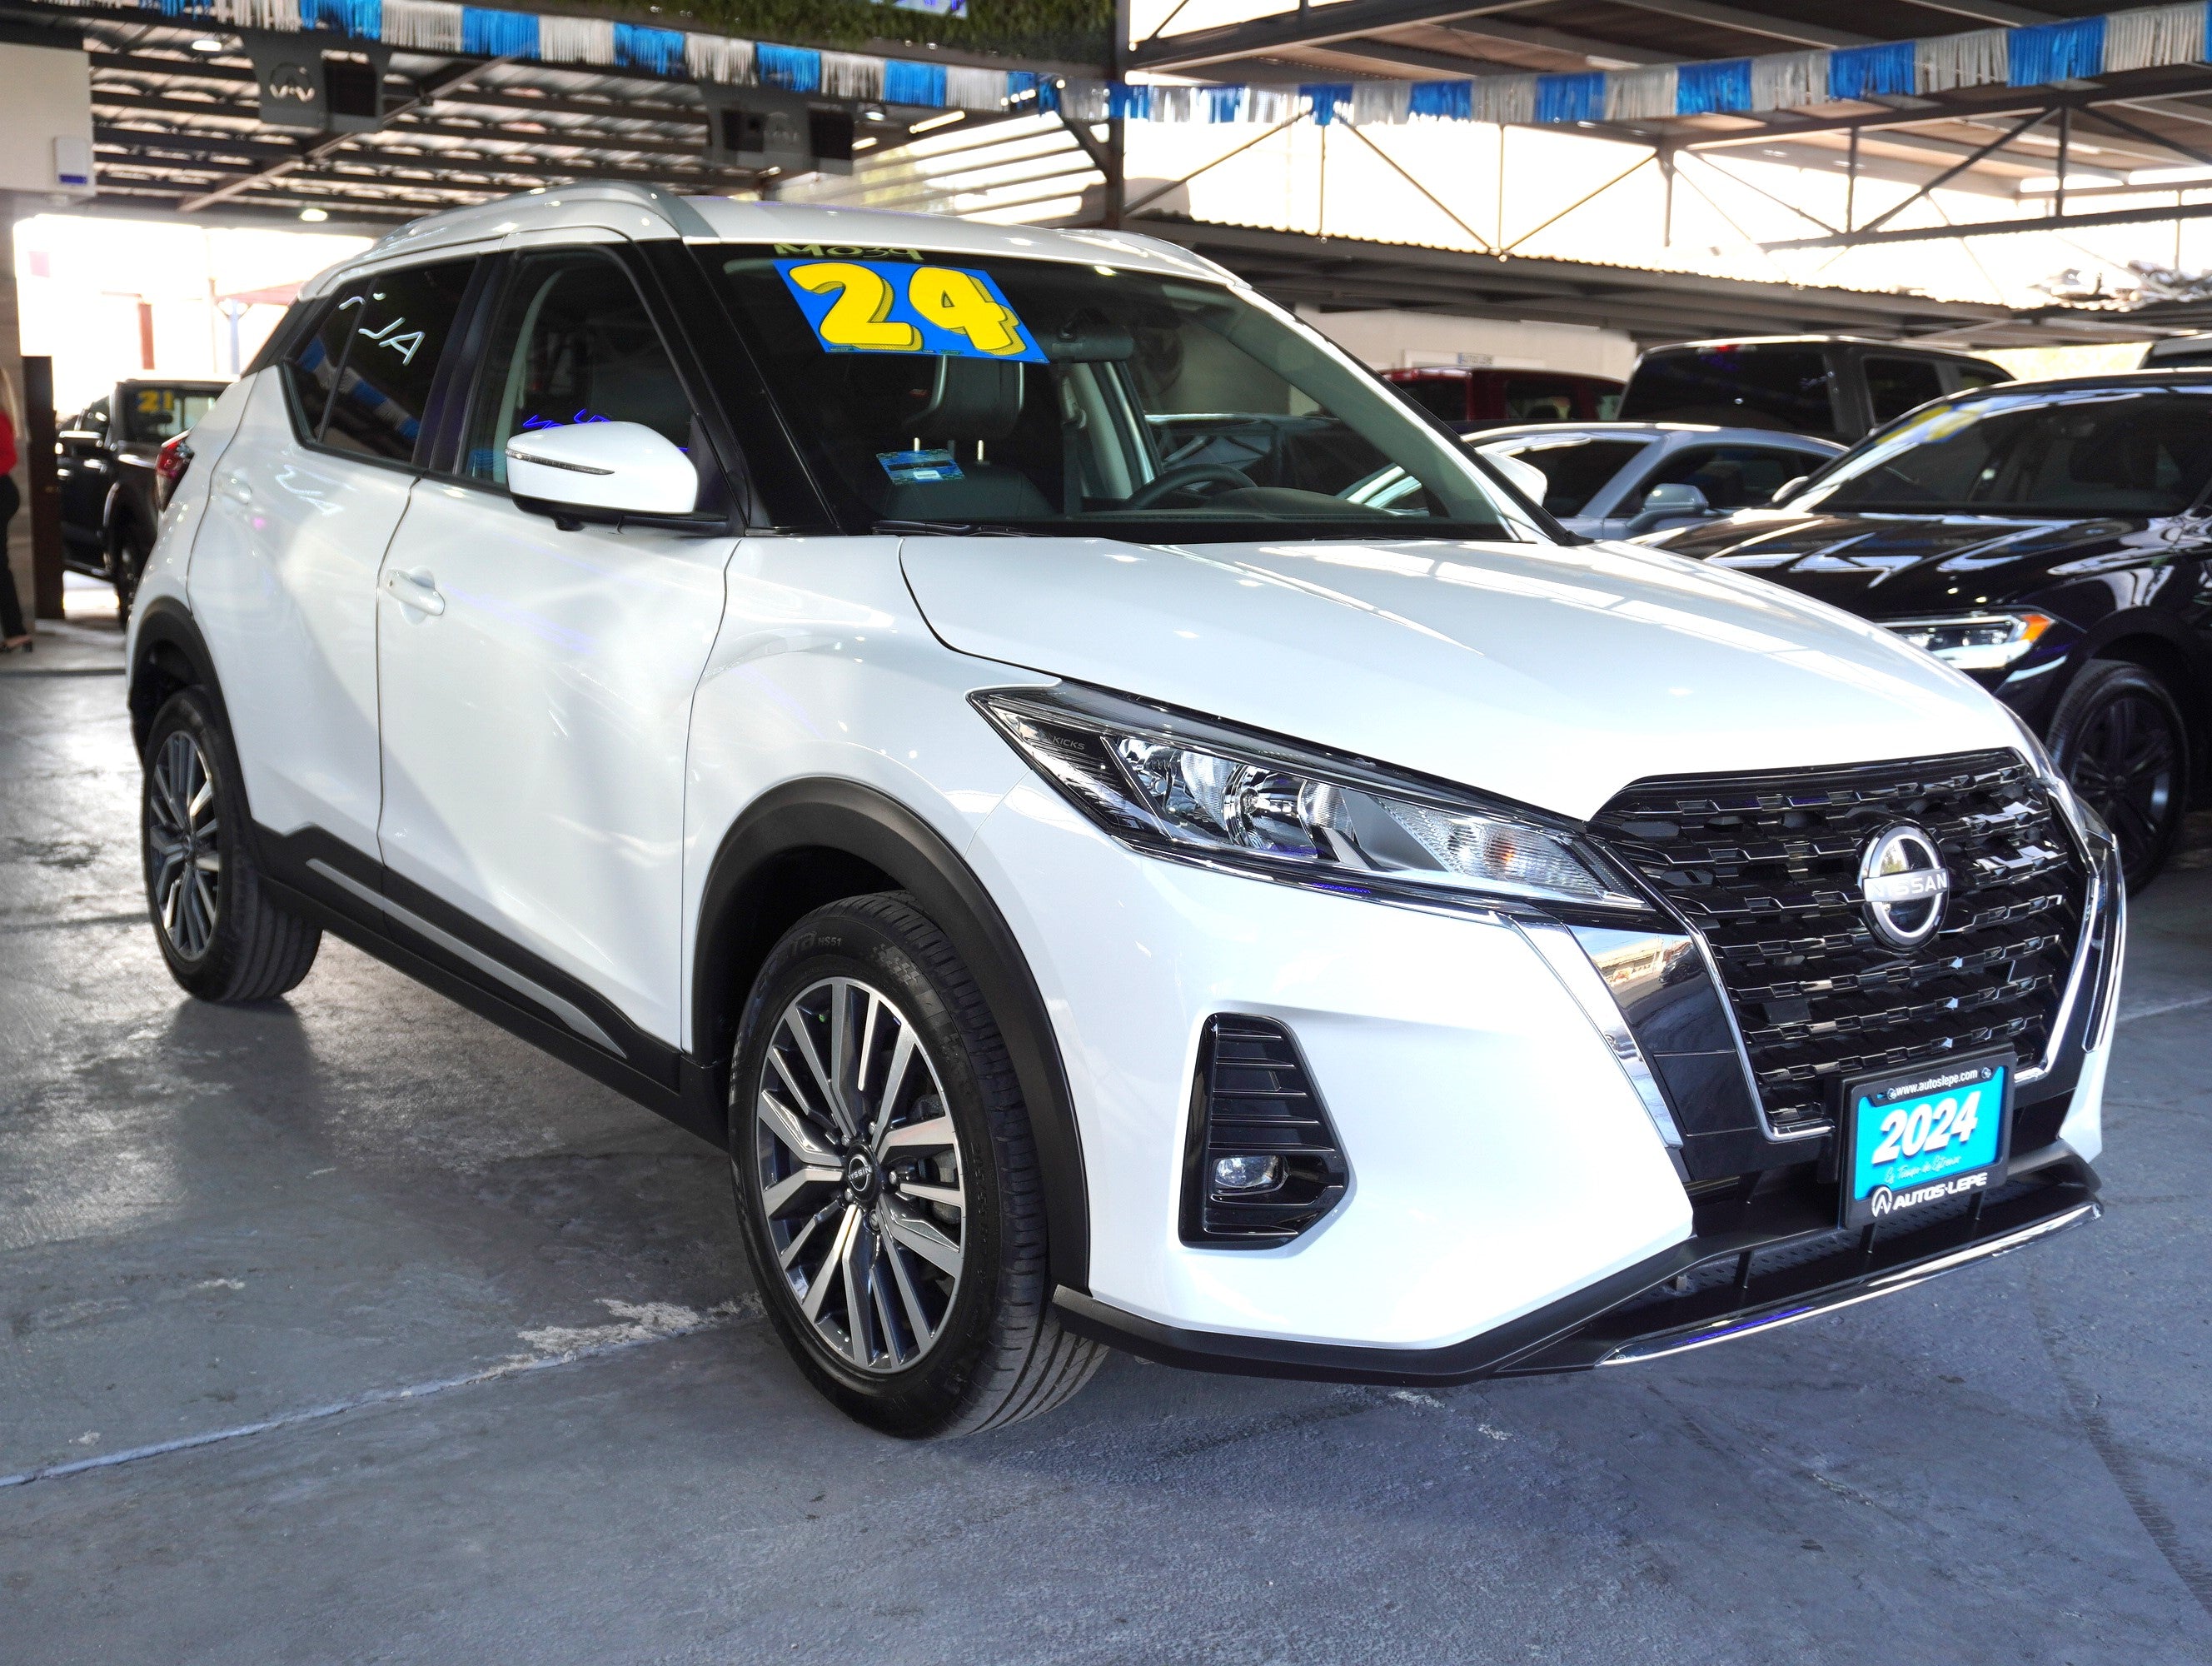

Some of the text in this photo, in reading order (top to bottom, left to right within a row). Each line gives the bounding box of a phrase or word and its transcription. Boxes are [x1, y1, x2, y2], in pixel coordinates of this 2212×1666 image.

[789, 262, 1026, 355] 24
[137, 390, 174, 412] 21
[1053, 736, 1085, 750] KICKS
[1867, 873, 1946, 897] NISSAN
[818, 936, 842, 947] HS51
[1896, 1069, 1978, 1095] www.autoslepe.com
[1871, 1090, 1981, 1165] 2024
